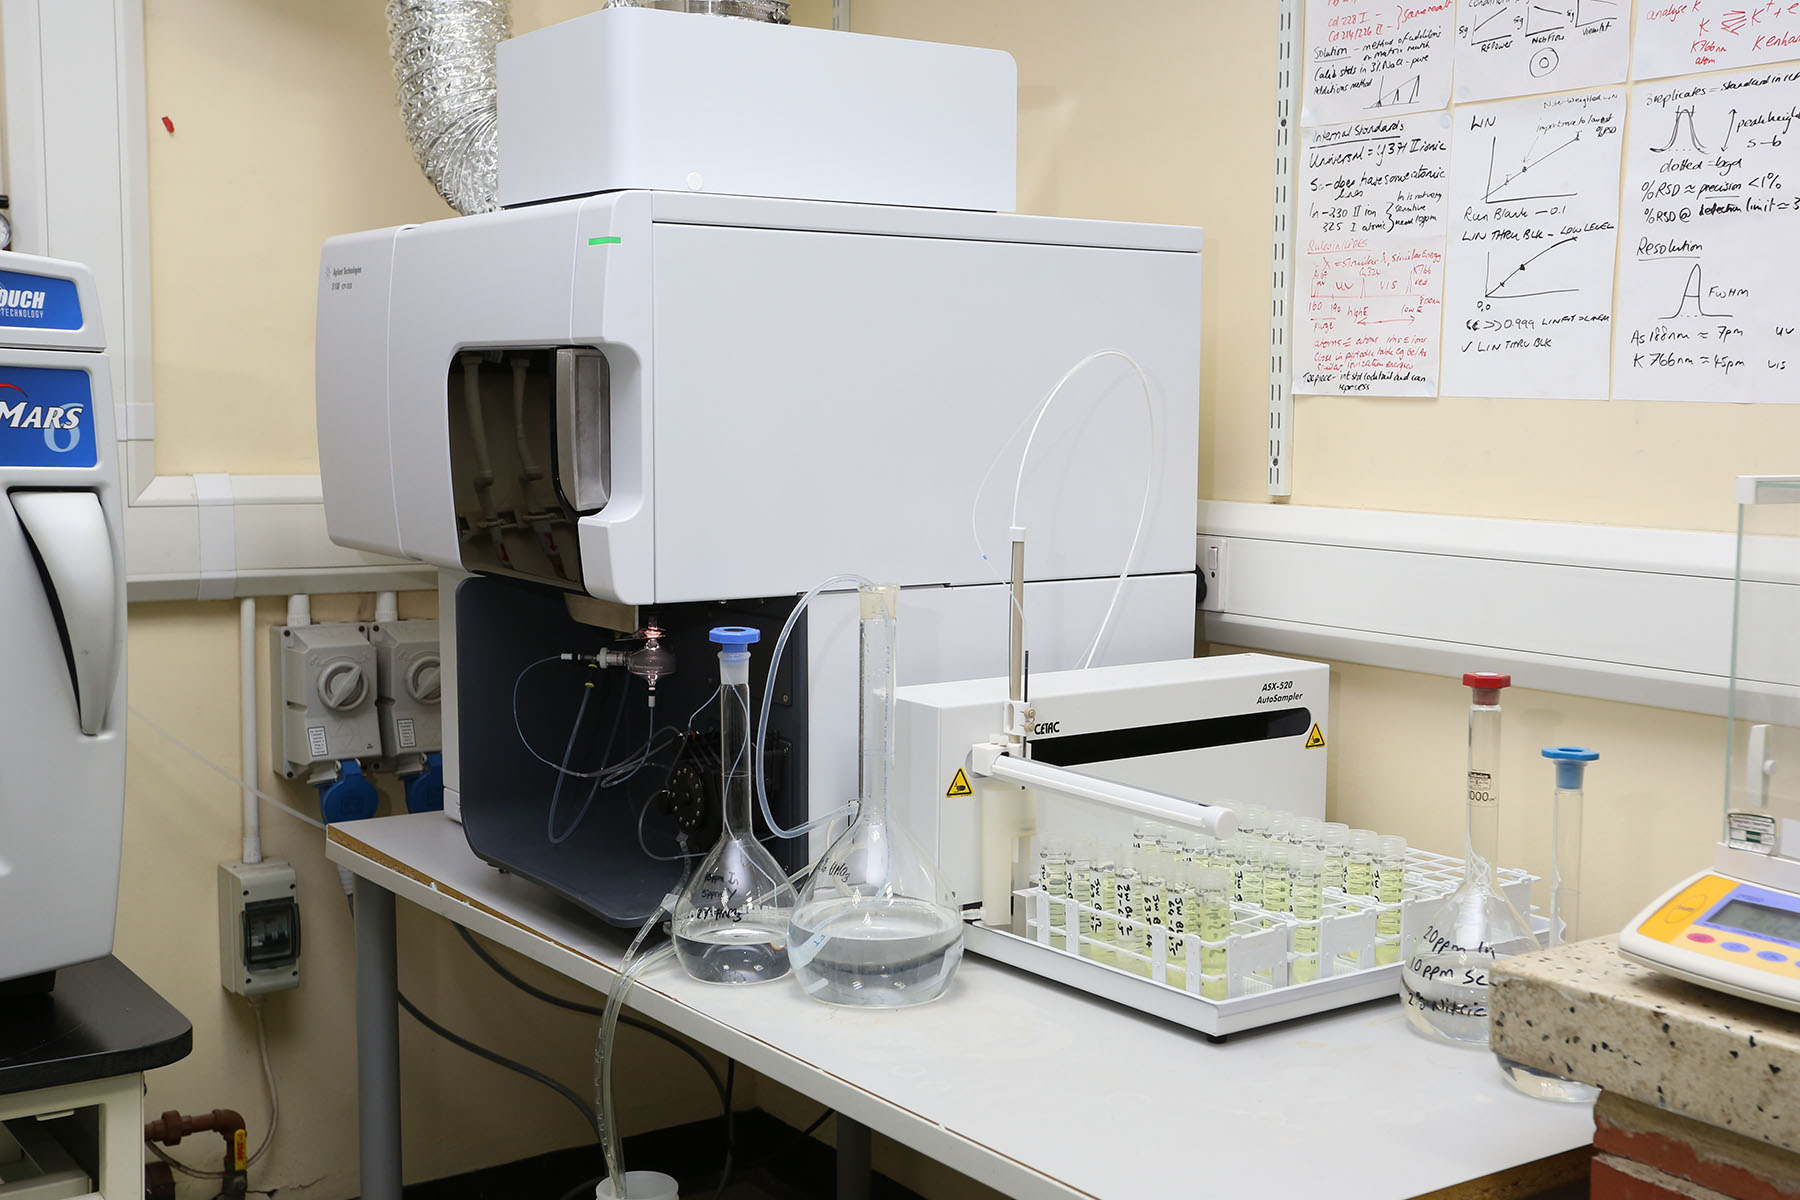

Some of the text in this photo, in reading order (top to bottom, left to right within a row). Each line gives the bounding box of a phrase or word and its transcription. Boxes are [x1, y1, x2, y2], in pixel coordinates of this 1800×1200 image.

[1699, 17, 1710, 36] K
[1314, 46, 1348, 60] Solution
[1362, 38, 1394, 52] method
[1752, 34, 1766, 51] K
[1313, 119, 1404, 143] Internal Standards
[1470, 115, 1496, 131] LIN
[1309, 146, 1364, 168] Universal
[1660, 159, 1703, 173] dotted
[1464, 206, 1489, 221] Run
[1493, 207, 1529, 221] Blank
[1462, 231, 1487, 241] LIN
[1560, 225, 1582, 235] LOW
[1637, 236, 1703, 256] Resolution
[1478, 342, 1501, 352] LIN
[1534, 337, 1552, 348] BLK
[1634, 353, 1645, 368] K
[0, 400, 84, 430] MARS
[1261, 680, 1293, 692] ASX-520
[1256, 692, 1303, 705] AutoSampler
[1034, 721, 1060, 735] CETAC
[1423, 925, 1466, 955] 20ppm
[1409, 956, 1454, 981] 10ppm
[1431, 998, 1488, 1016] Nitric
